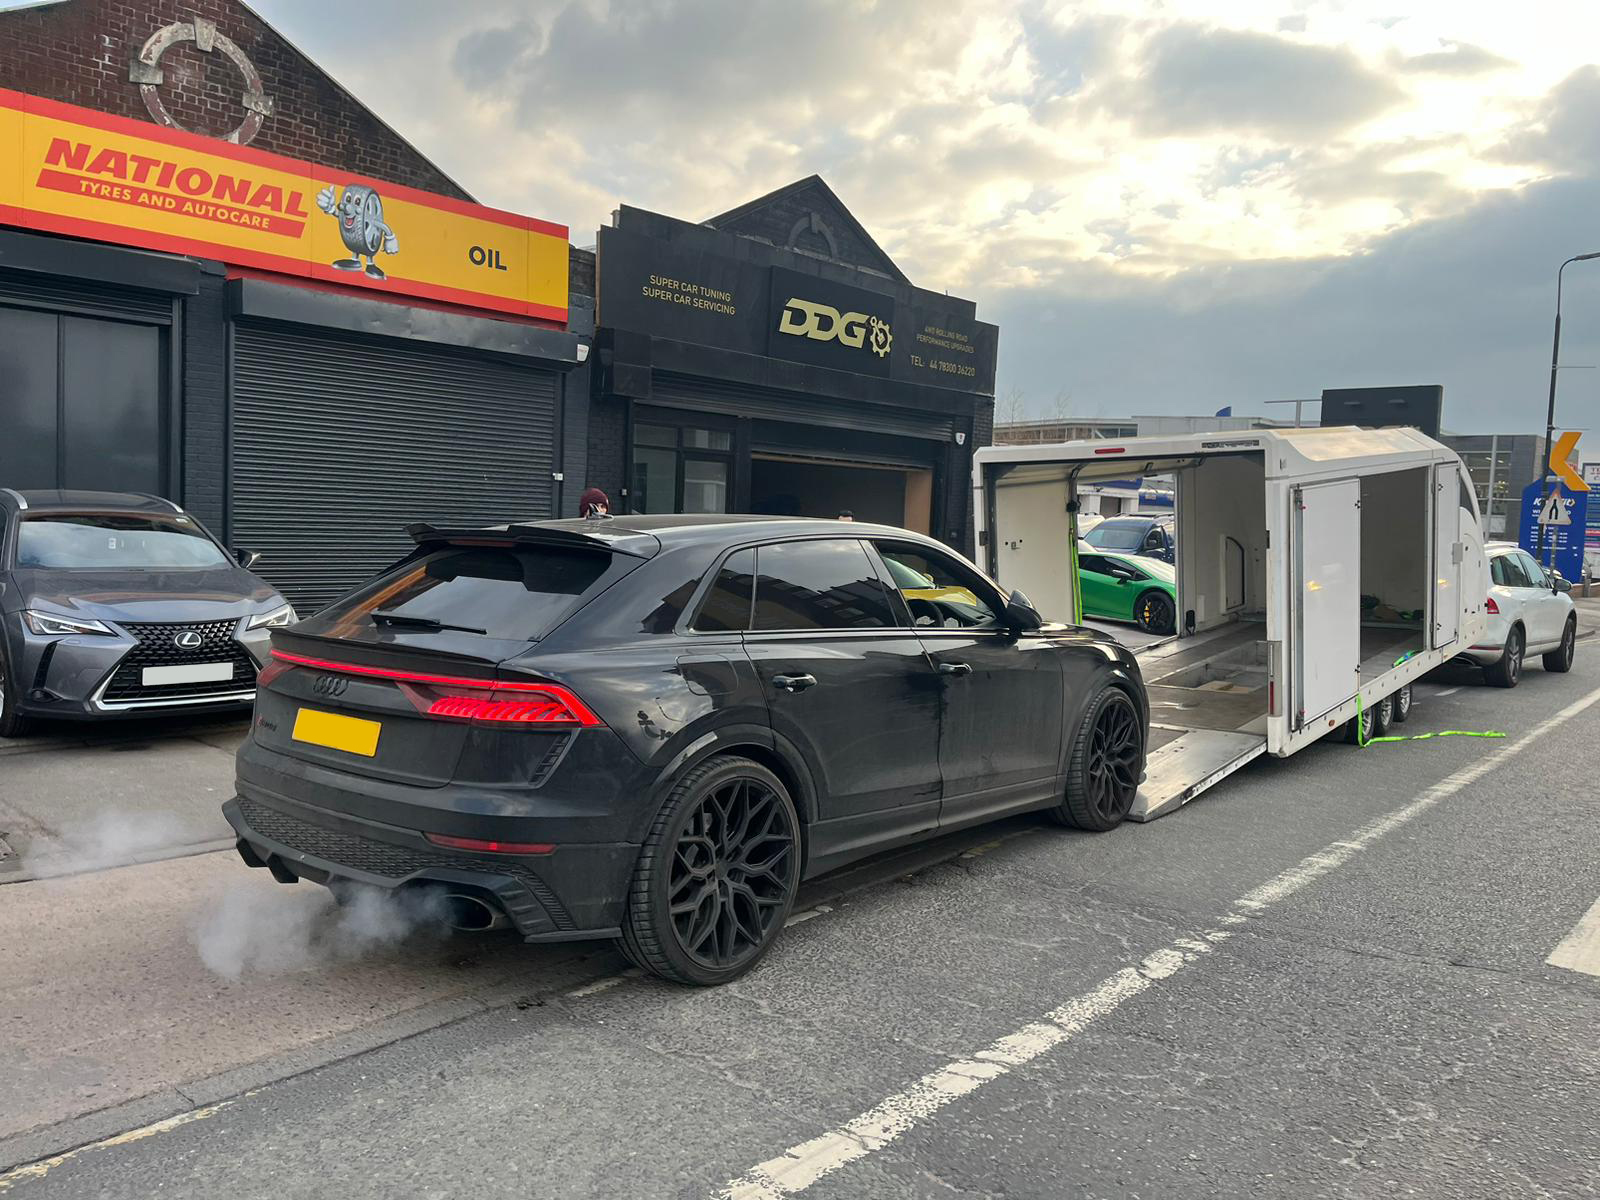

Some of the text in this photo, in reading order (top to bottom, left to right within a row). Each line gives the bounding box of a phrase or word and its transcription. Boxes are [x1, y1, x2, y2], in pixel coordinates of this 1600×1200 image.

[44, 137, 309, 218] NATIONAL
[79, 180, 270, 229] TYRES AND AUTOCARE
[468, 245, 507, 271] OIL
[642, 286, 736, 315] SUPER CAR SERVICING
[650, 274, 731, 302] SUPER CAR TUNING
[779, 297, 870, 349] DDG
[916, 333, 950, 348] PERFORMANCE
